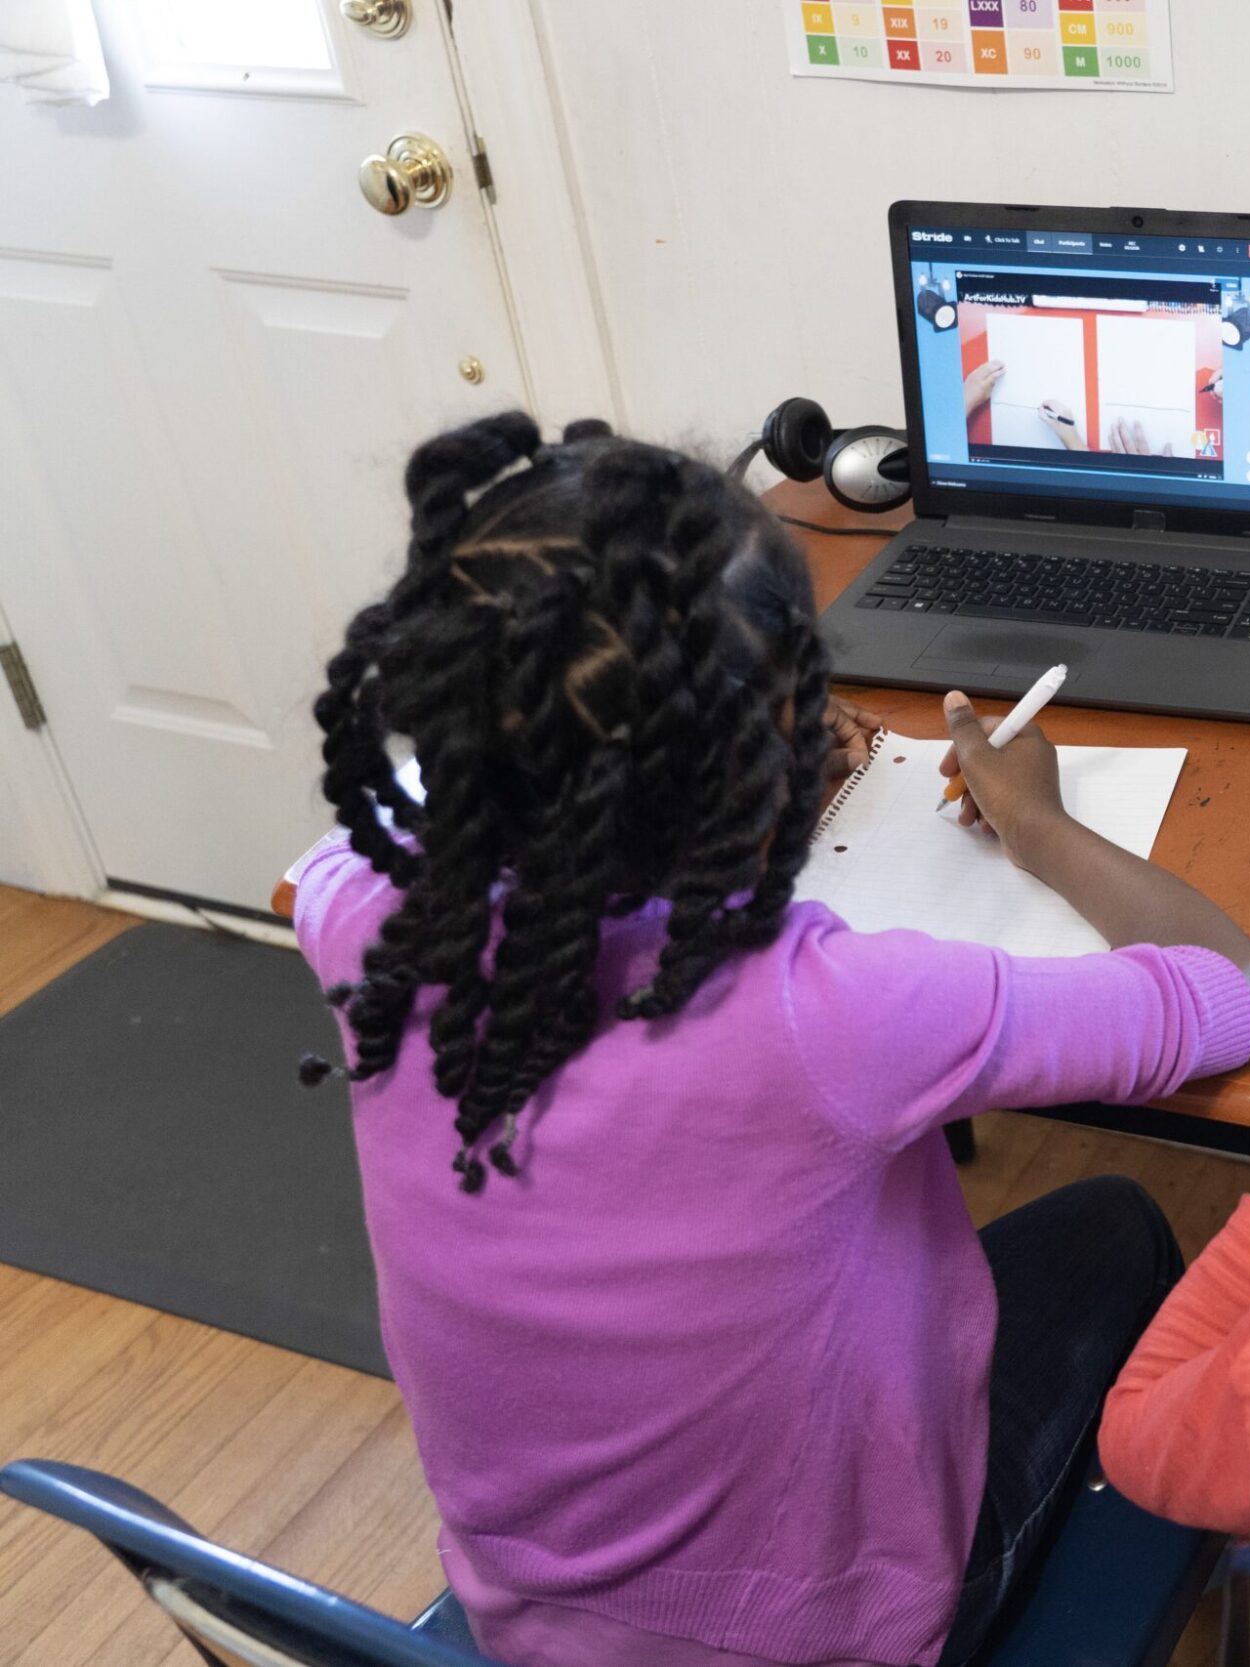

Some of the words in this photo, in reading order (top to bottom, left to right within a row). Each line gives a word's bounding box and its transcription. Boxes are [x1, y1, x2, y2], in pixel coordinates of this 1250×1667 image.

[970, 1, 999, 11] LXXX
[1020, 0, 1036, 12] 80
[812, 14, 822, 23] IX
[852, 14, 860, 25] 9
[890, 18, 908, 28] XIX
[933, 19, 948, 30] 19
[1068, 24, 1087, 34] CM
[1107, 23, 1134, 36] 900
[819, 45, 826, 55] X
[854, 47, 868, 58] 10
[896, 51, 910, 60] XX
[936, 51, 951, 62] 20
[981, 48, 997, 58] XC
[1024, 48, 1041, 60] 90
[1076, 57, 1085, 67] M
[1106, 56, 1141, 68] 1000
[911, 231, 953, 243] Stride
